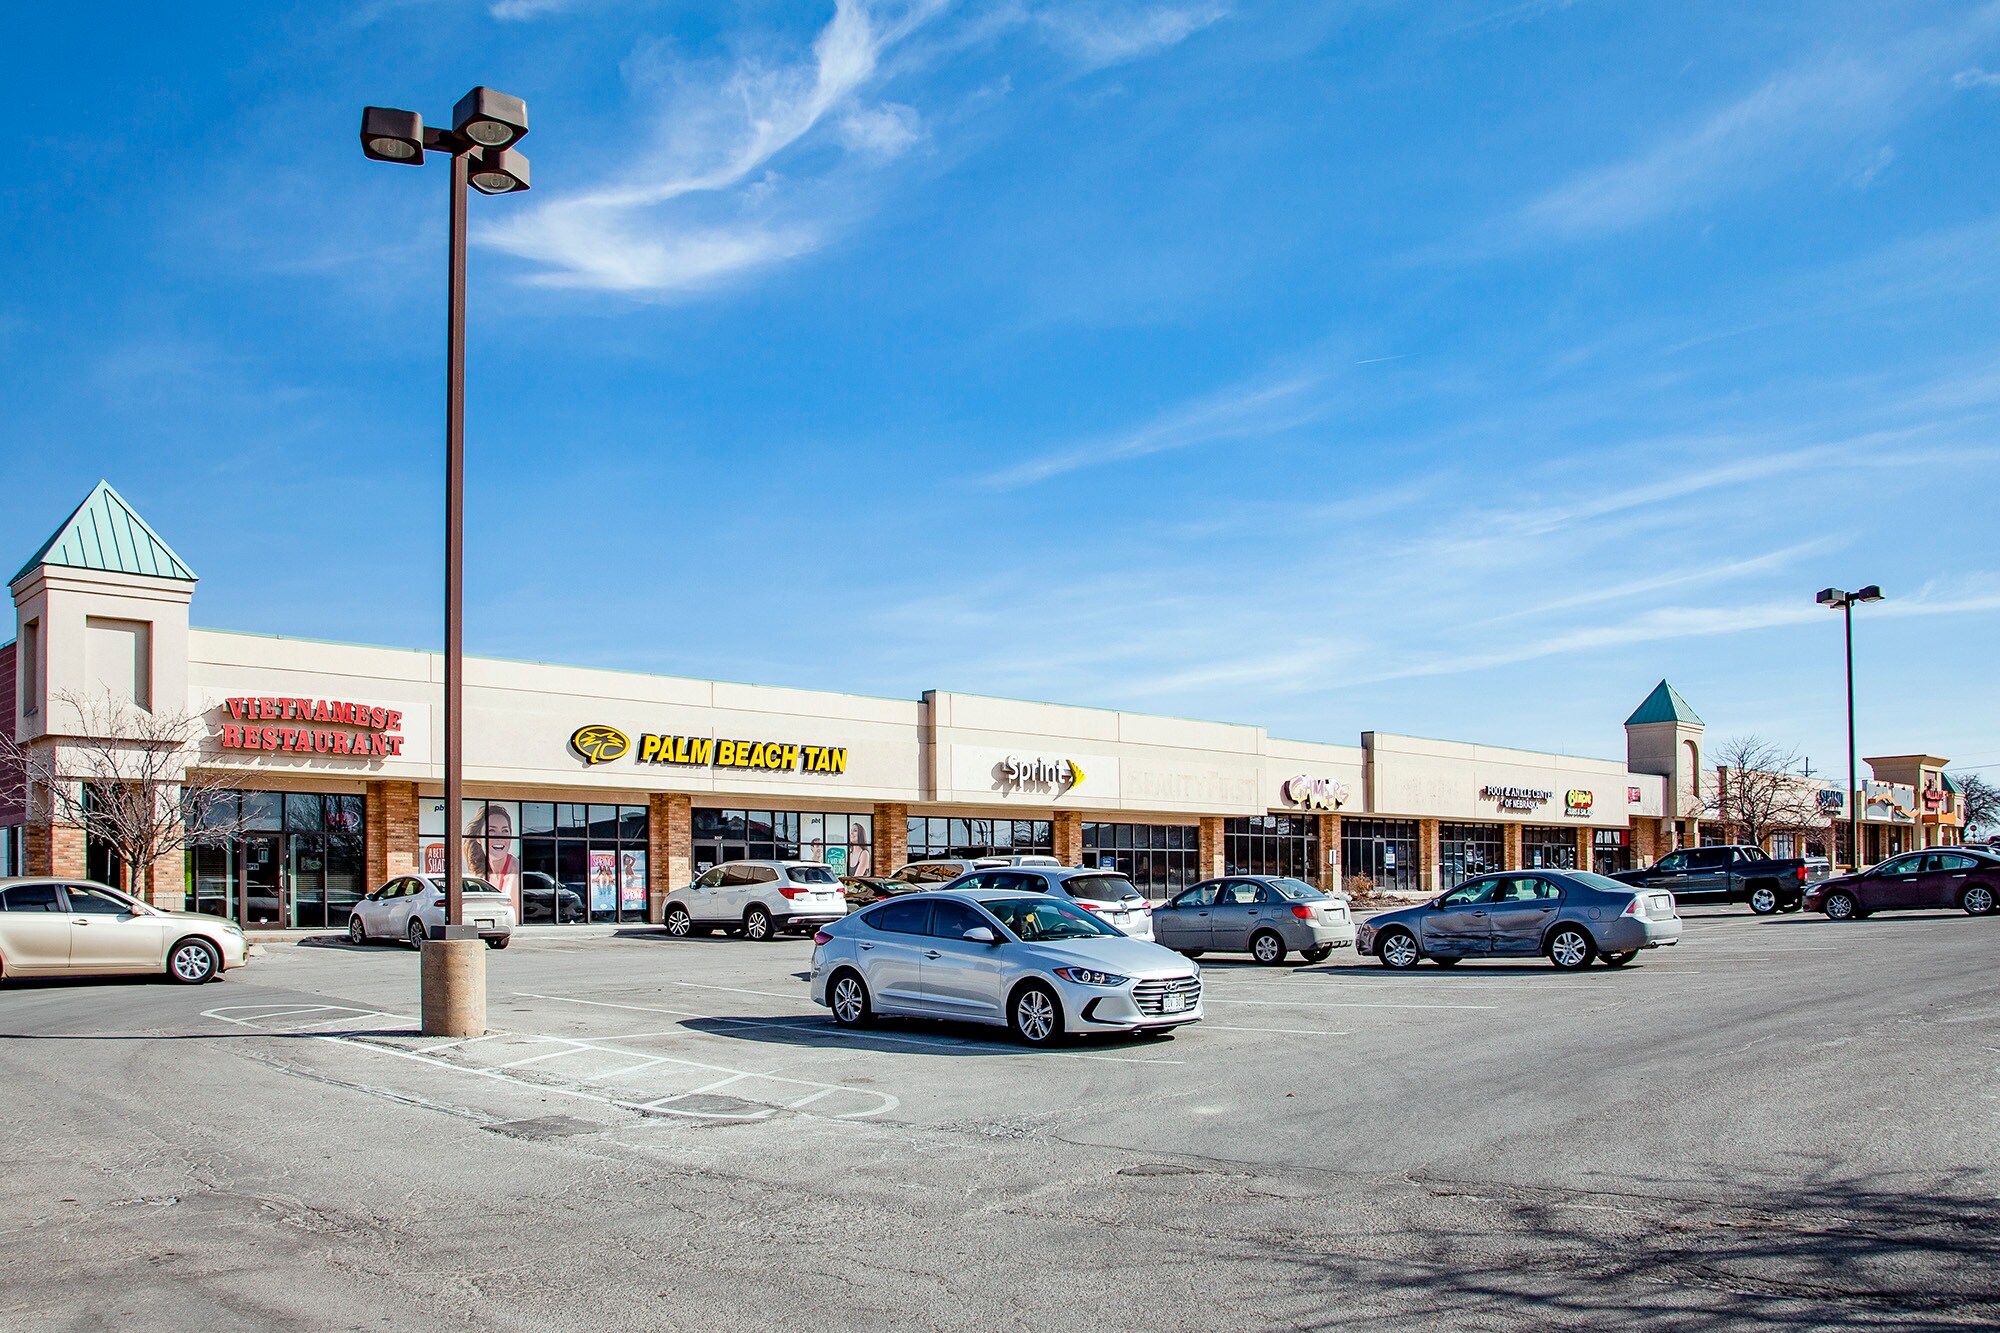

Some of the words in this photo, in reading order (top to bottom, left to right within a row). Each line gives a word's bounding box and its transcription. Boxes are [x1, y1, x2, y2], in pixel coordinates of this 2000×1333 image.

[226, 697, 403, 732] VIETNAMESE
[222, 724, 405, 757] RESTAURANT
[641, 733, 713, 765] PALM
[716, 739, 798, 769] BEACH
[802, 746, 848, 773] TAN
[1003, 754, 1067, 789] Sprint
[434, 804, 445, 812] pb
[1486, 785, 1504, 796] FOOT
[1511, 787, 1532, 798] ANKLE
